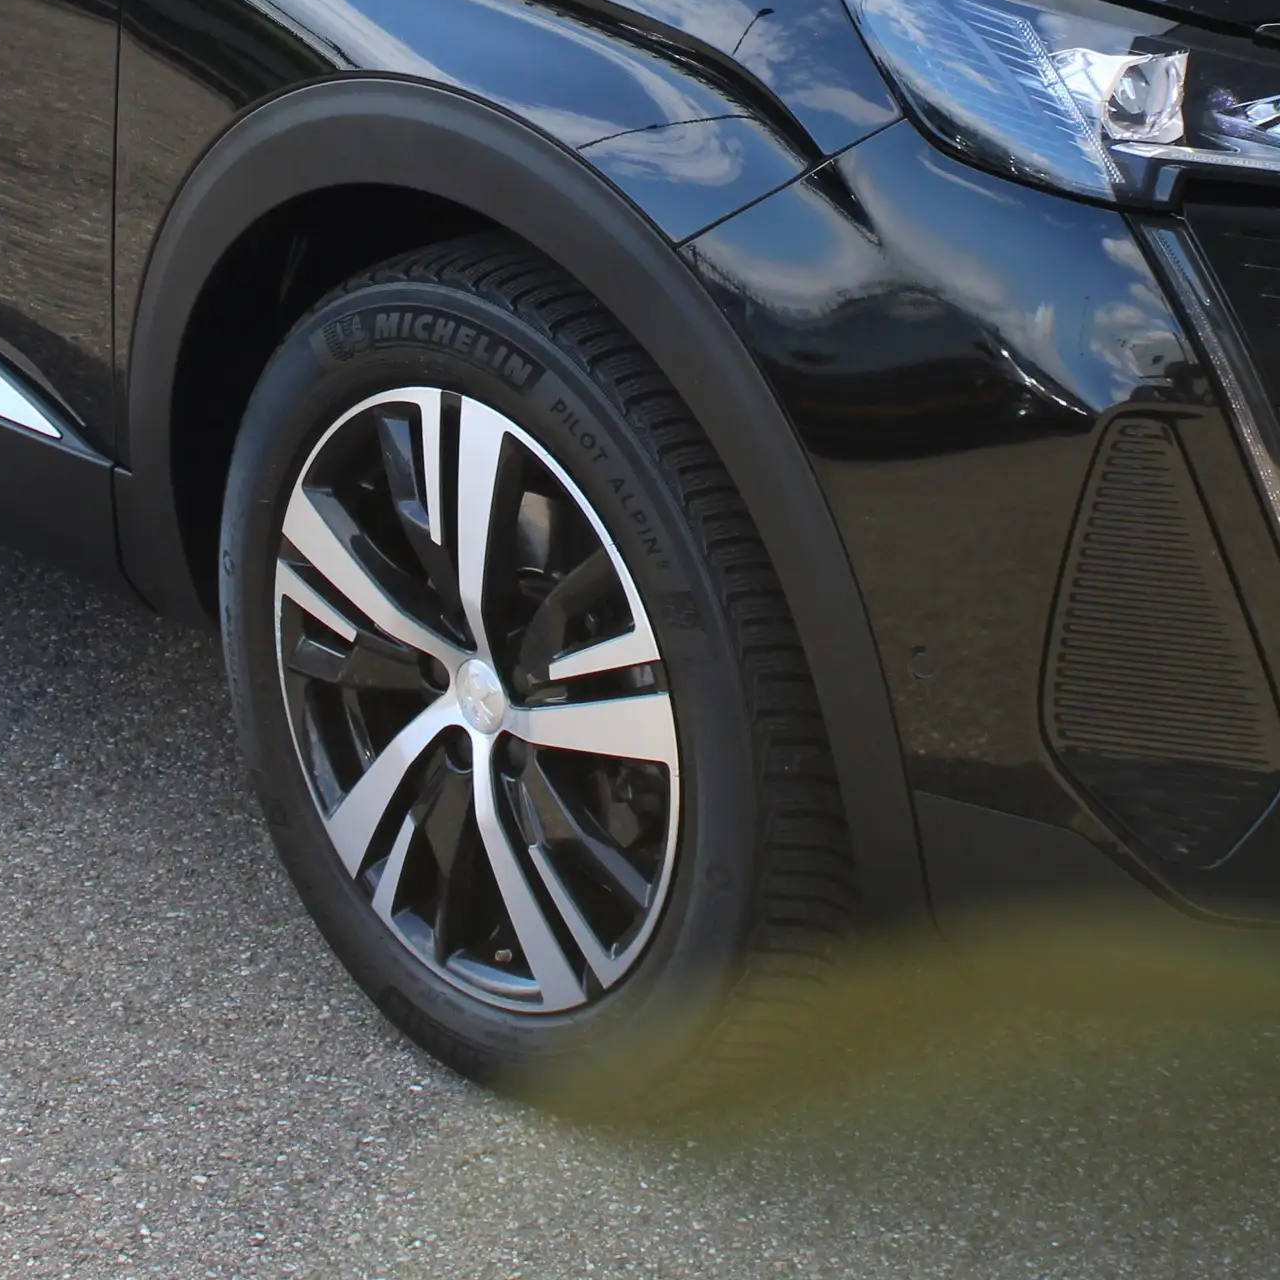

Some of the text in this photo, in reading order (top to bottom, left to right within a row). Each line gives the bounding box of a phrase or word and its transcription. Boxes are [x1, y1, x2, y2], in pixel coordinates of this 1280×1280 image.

[374, 312, 534, 387] MICHELIN
[549, 398, 609, 464] PILOT
[608, 477, 665, 556] ALPIN
